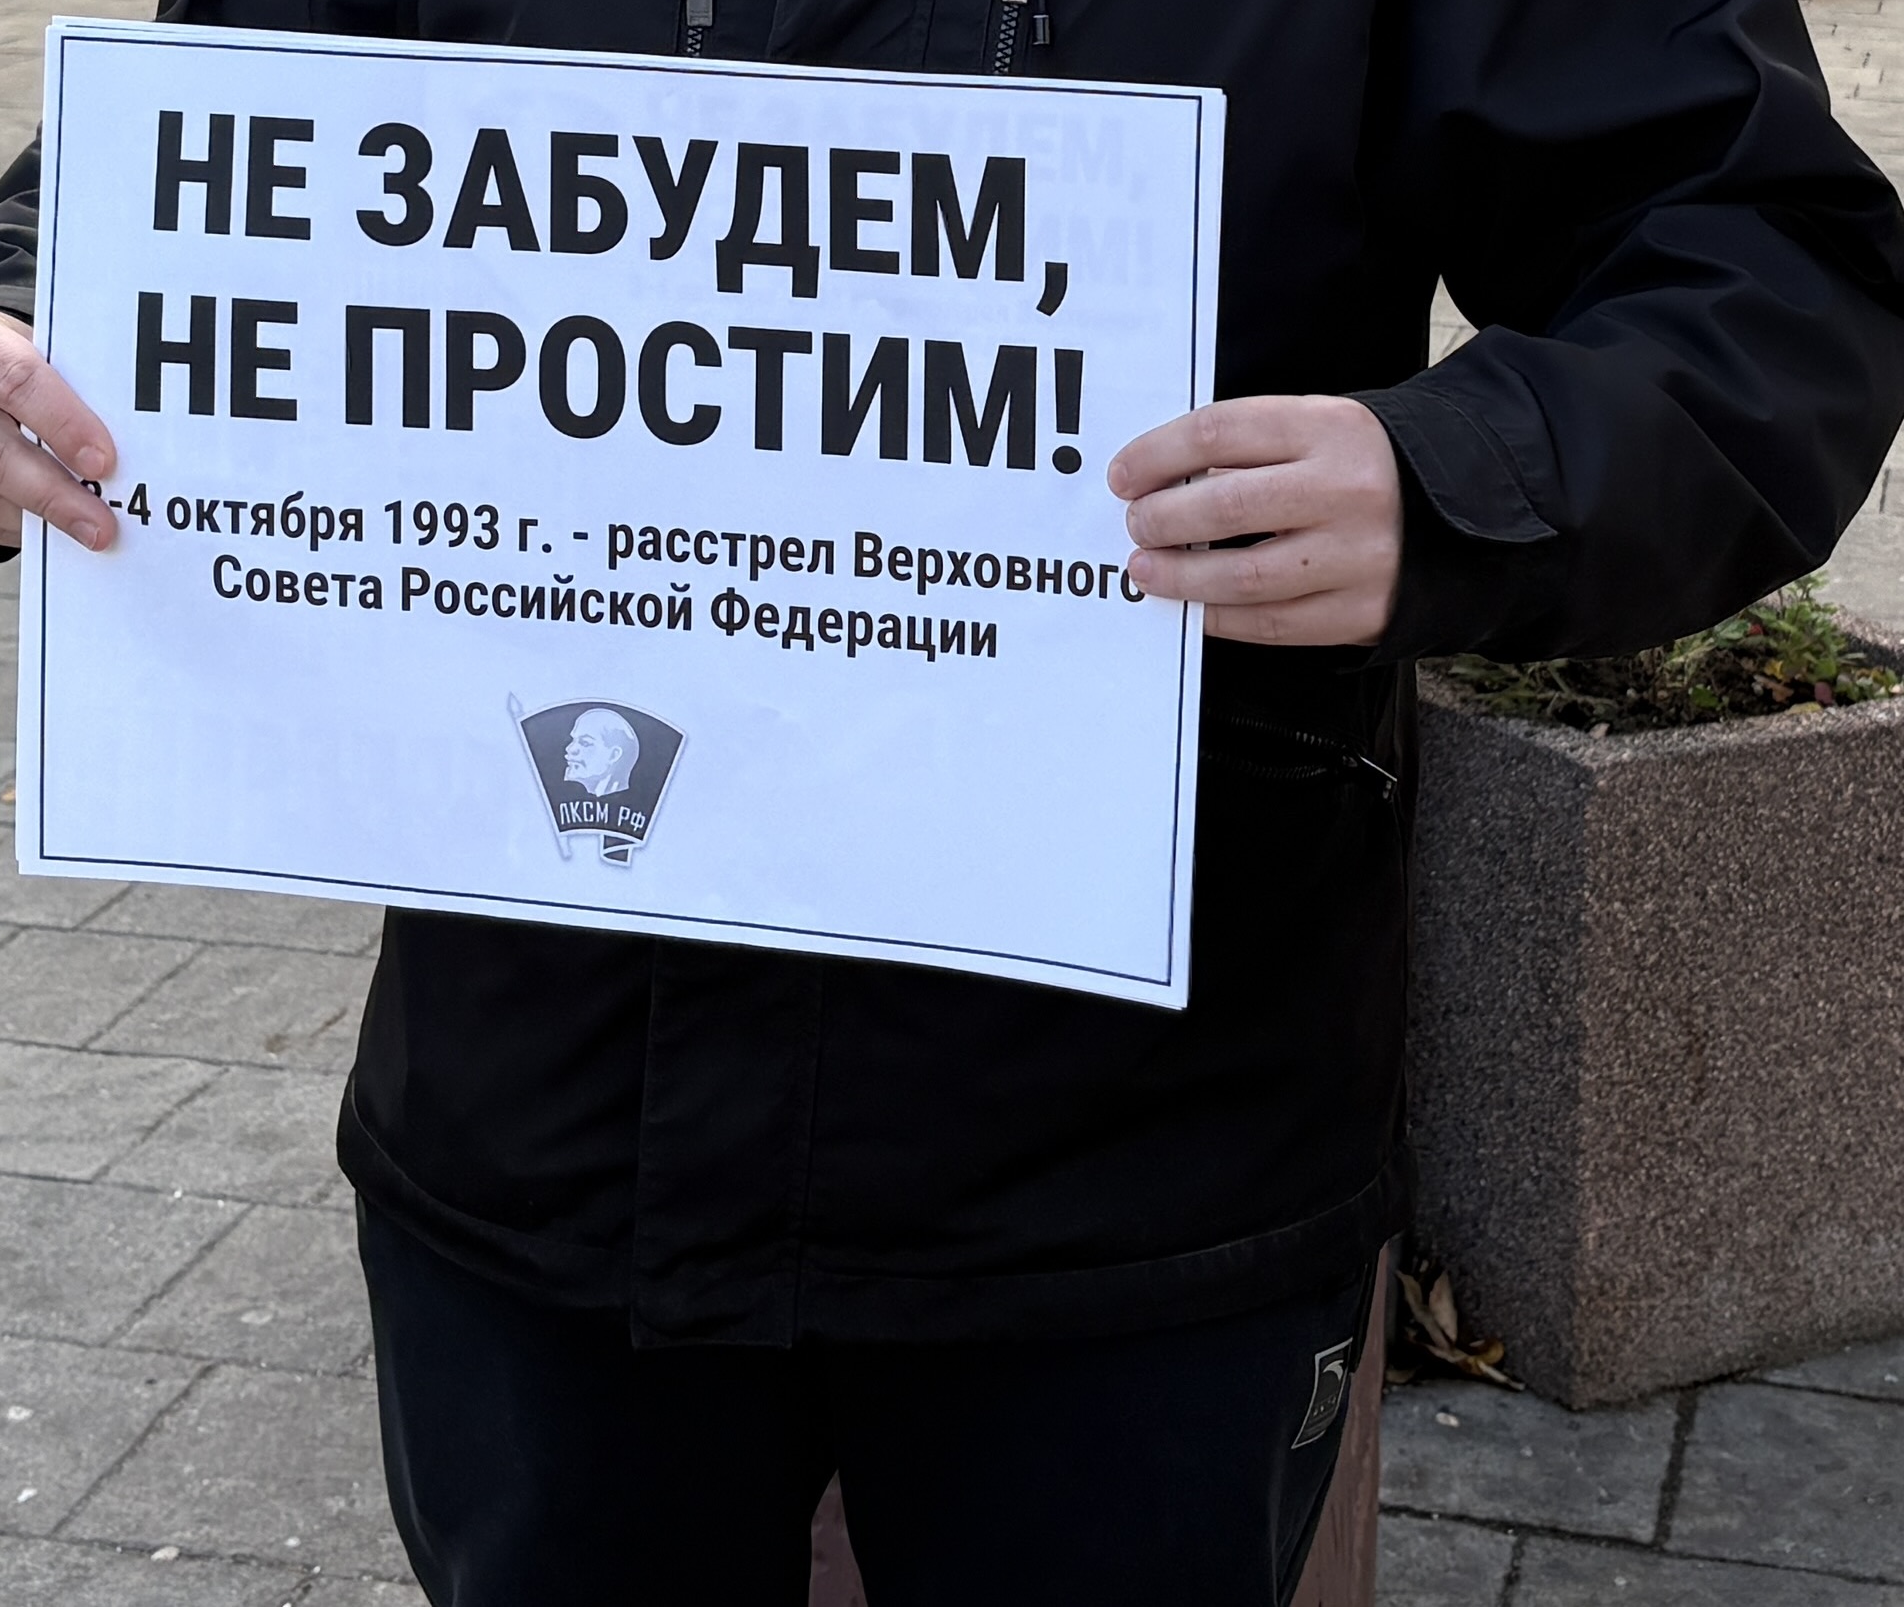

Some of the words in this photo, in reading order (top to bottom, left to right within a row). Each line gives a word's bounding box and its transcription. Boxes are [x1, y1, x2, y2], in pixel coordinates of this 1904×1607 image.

[153, 110, 314, 240] НЕ
[355, 122, 1068, 316] ЗАБУДЕМ,
[134, 291, 298, 421] НЕ
[345, 305, 1084, 475] ПРОСТИМ!
[166, 490, 364, 552] октября
[384, 500, 499, 550] 1993
[518, 518, 553, 553] г.
[608, 523, 835, 581] расстрел
[212, 554, 383, 610] Совета
[401, 566, 692, 631] Российской
[710, 587, 997, 663] Федерации
[559, 800, 609, 825] ЛКСМ
[617, 806, 646, 832] РФ
